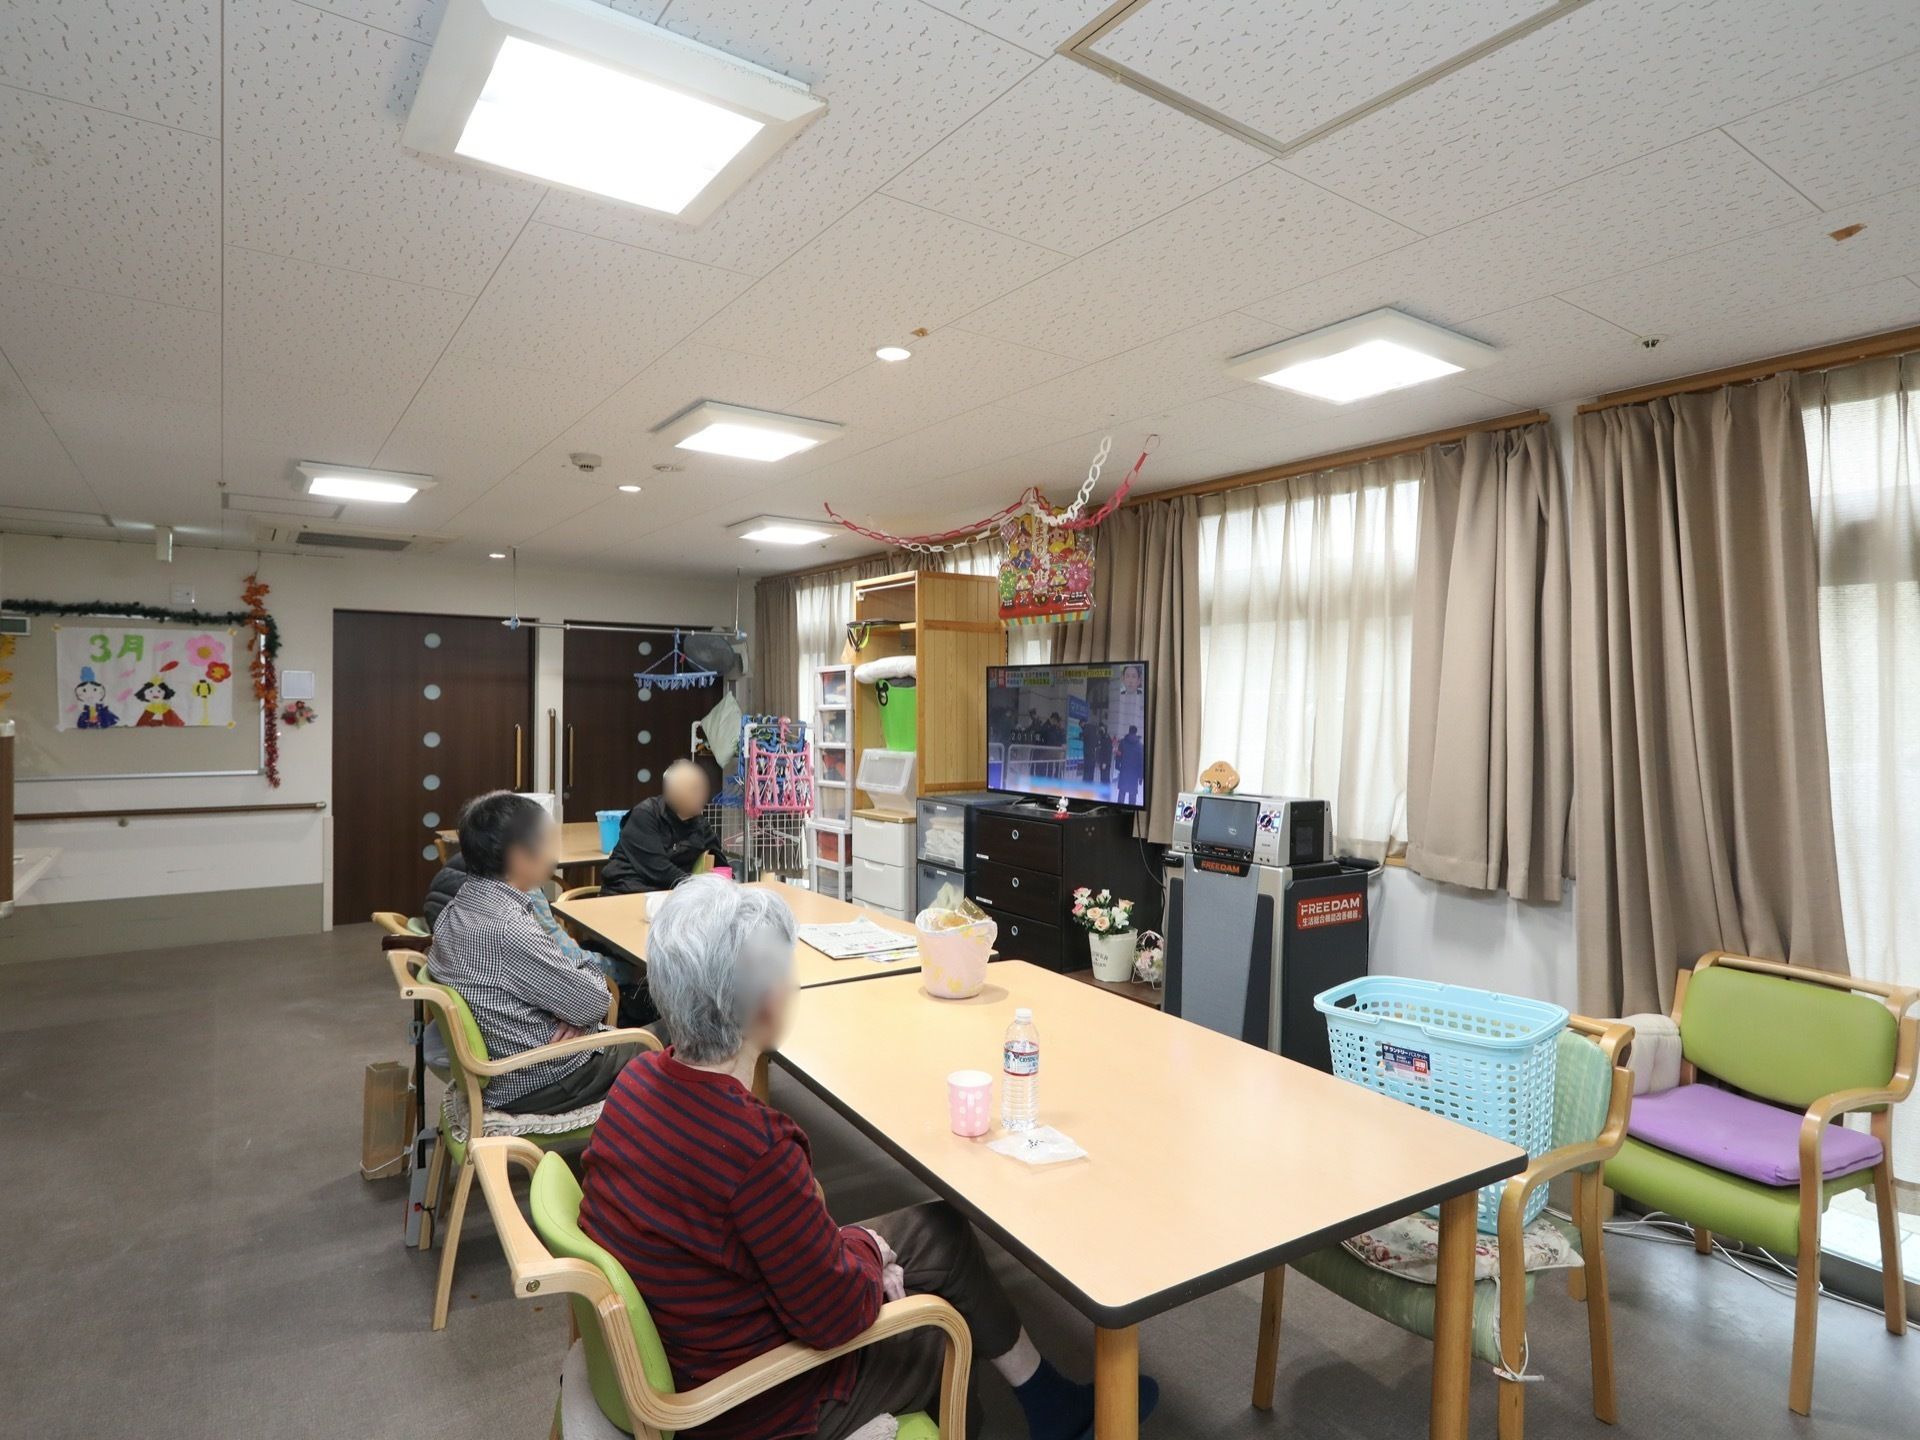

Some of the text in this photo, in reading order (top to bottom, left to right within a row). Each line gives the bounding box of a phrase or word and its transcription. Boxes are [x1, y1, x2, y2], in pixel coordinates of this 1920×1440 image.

[90, 634, 144, 662] 3月
[1200, 860, 1240, 874] FREEDAM
[1301, 897, 1360, 916] FREEDAM
